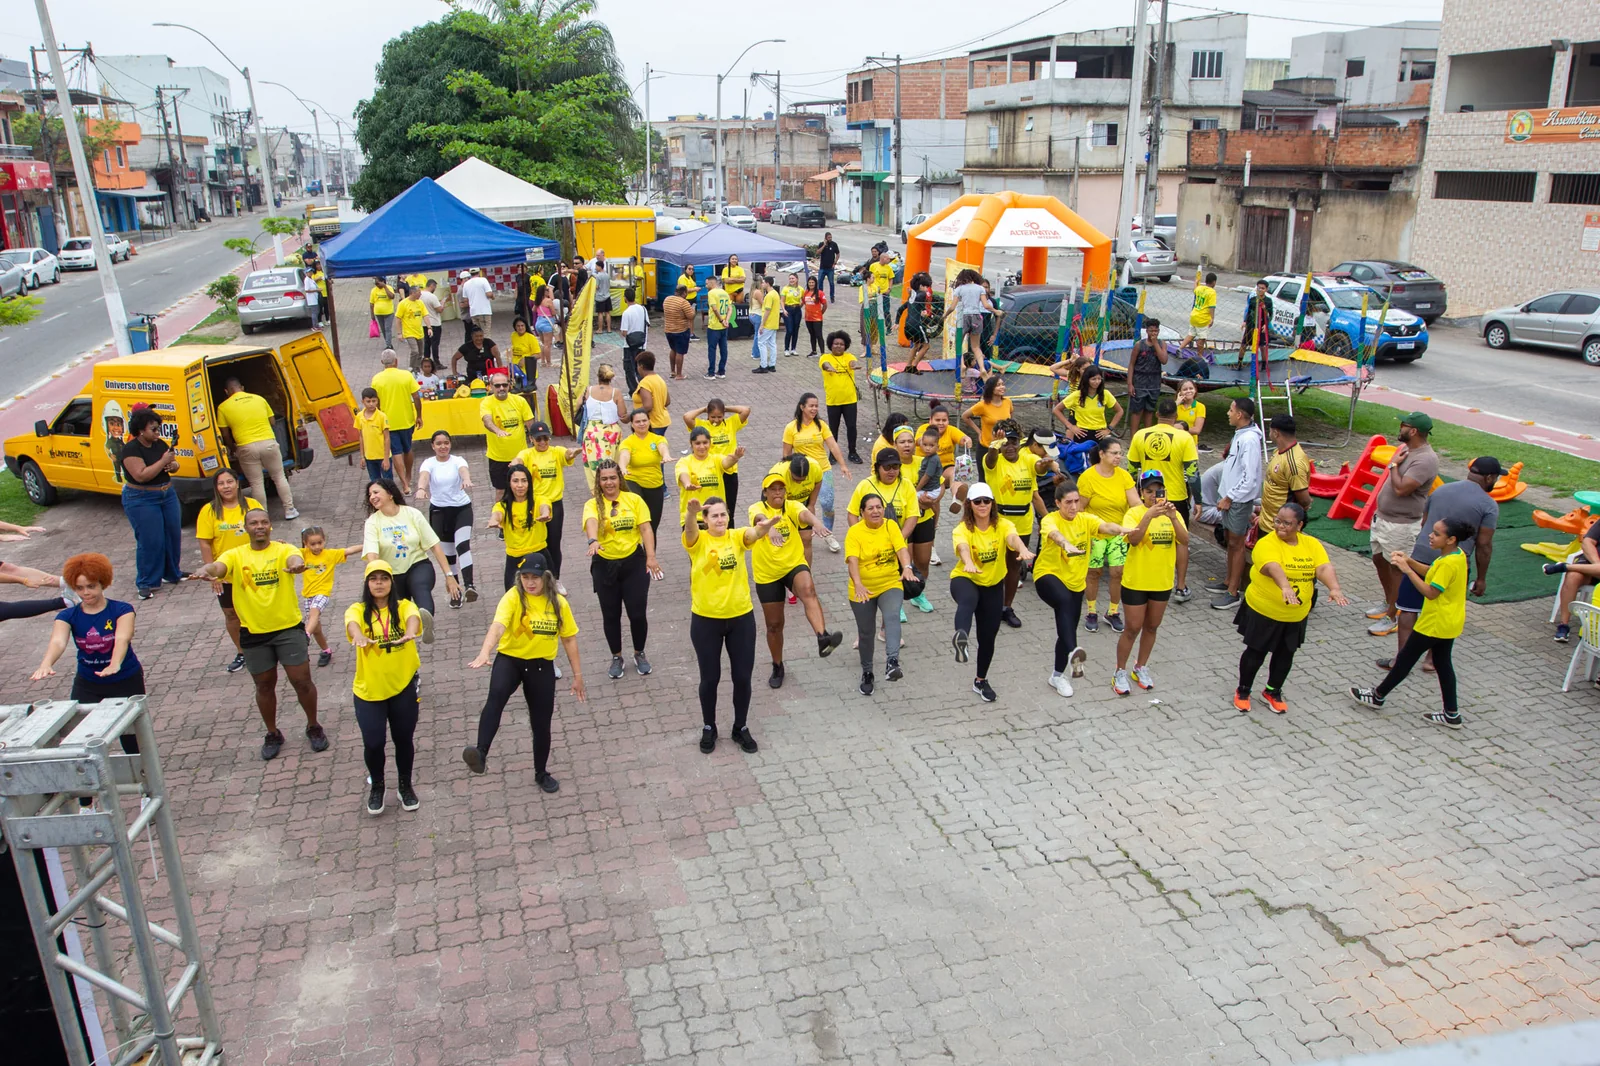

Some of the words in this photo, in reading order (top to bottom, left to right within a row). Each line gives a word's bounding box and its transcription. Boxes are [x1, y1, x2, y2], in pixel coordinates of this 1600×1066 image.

[1542, 110, 1598, 126] Assembleia
[1275, 308, 1295, 319] POLÍCIA
[1274, 316, 1294, 326] MILITAR
[104, 380, 137, 390] Universo
[137, 382, 170, 391] offshore
